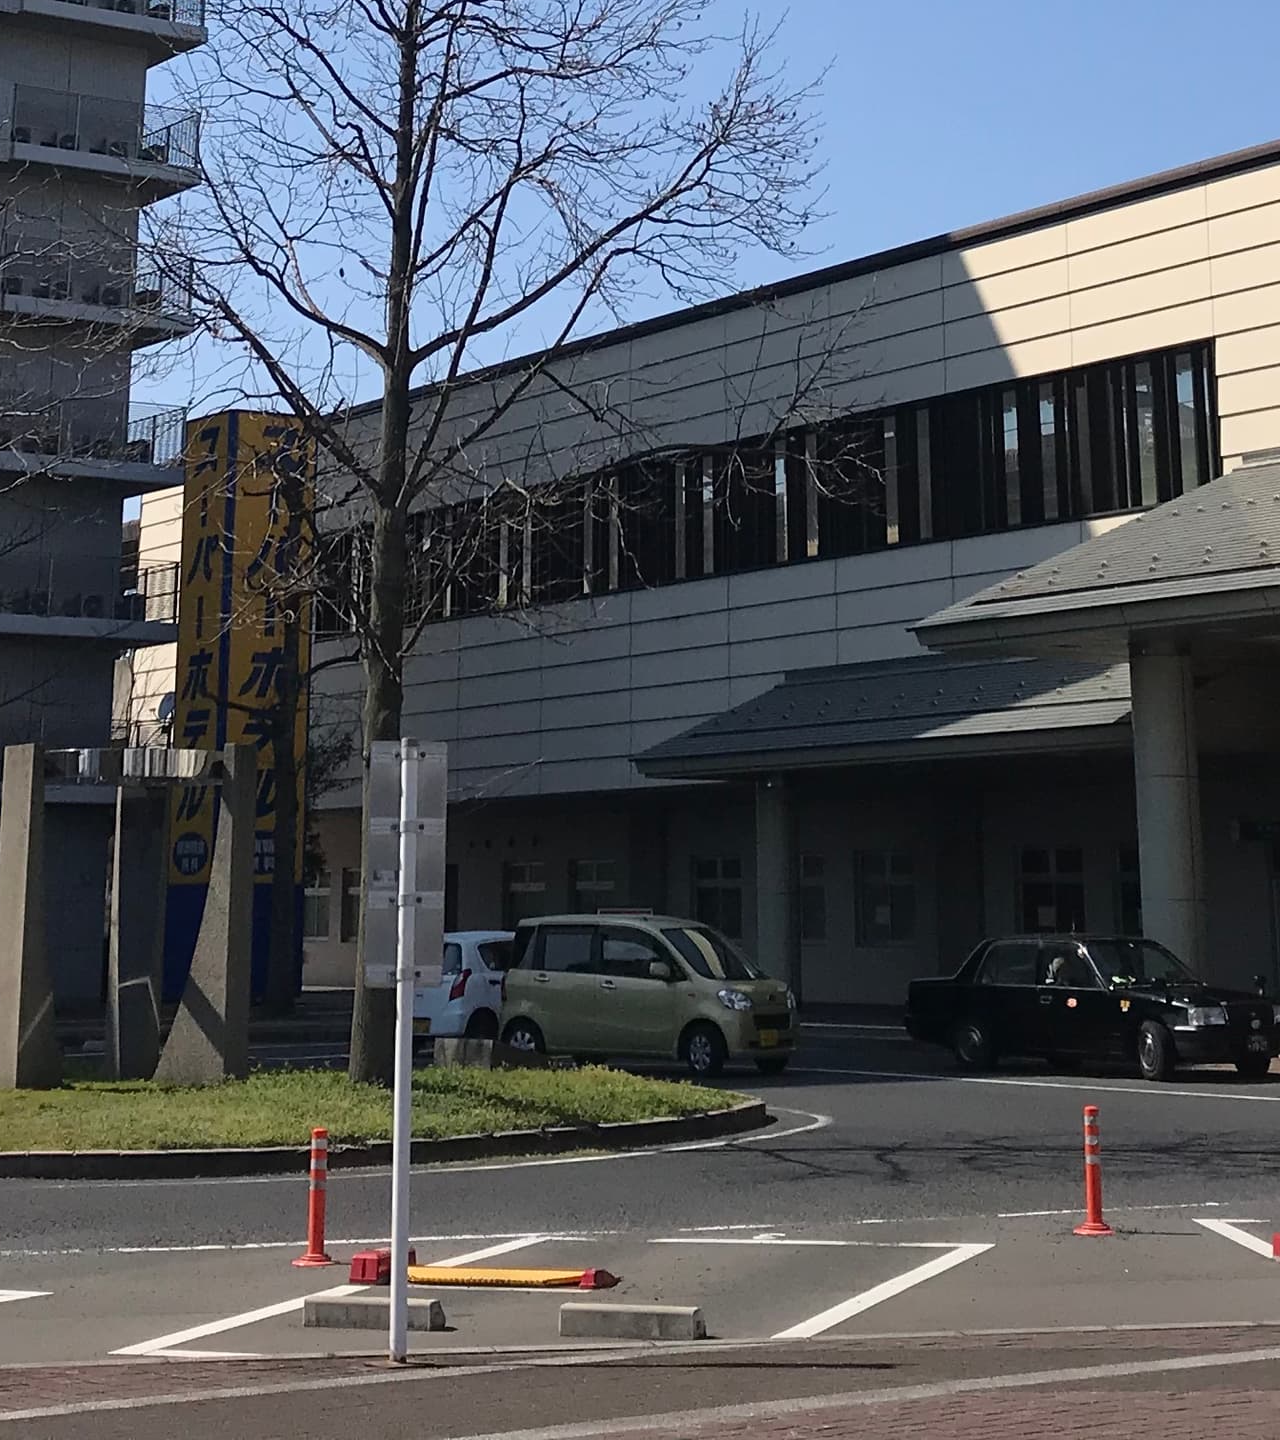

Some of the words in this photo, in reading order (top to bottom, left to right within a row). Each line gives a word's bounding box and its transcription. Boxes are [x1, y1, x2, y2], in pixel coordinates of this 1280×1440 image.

[176, 426, 219, 821] スーパーホテル
